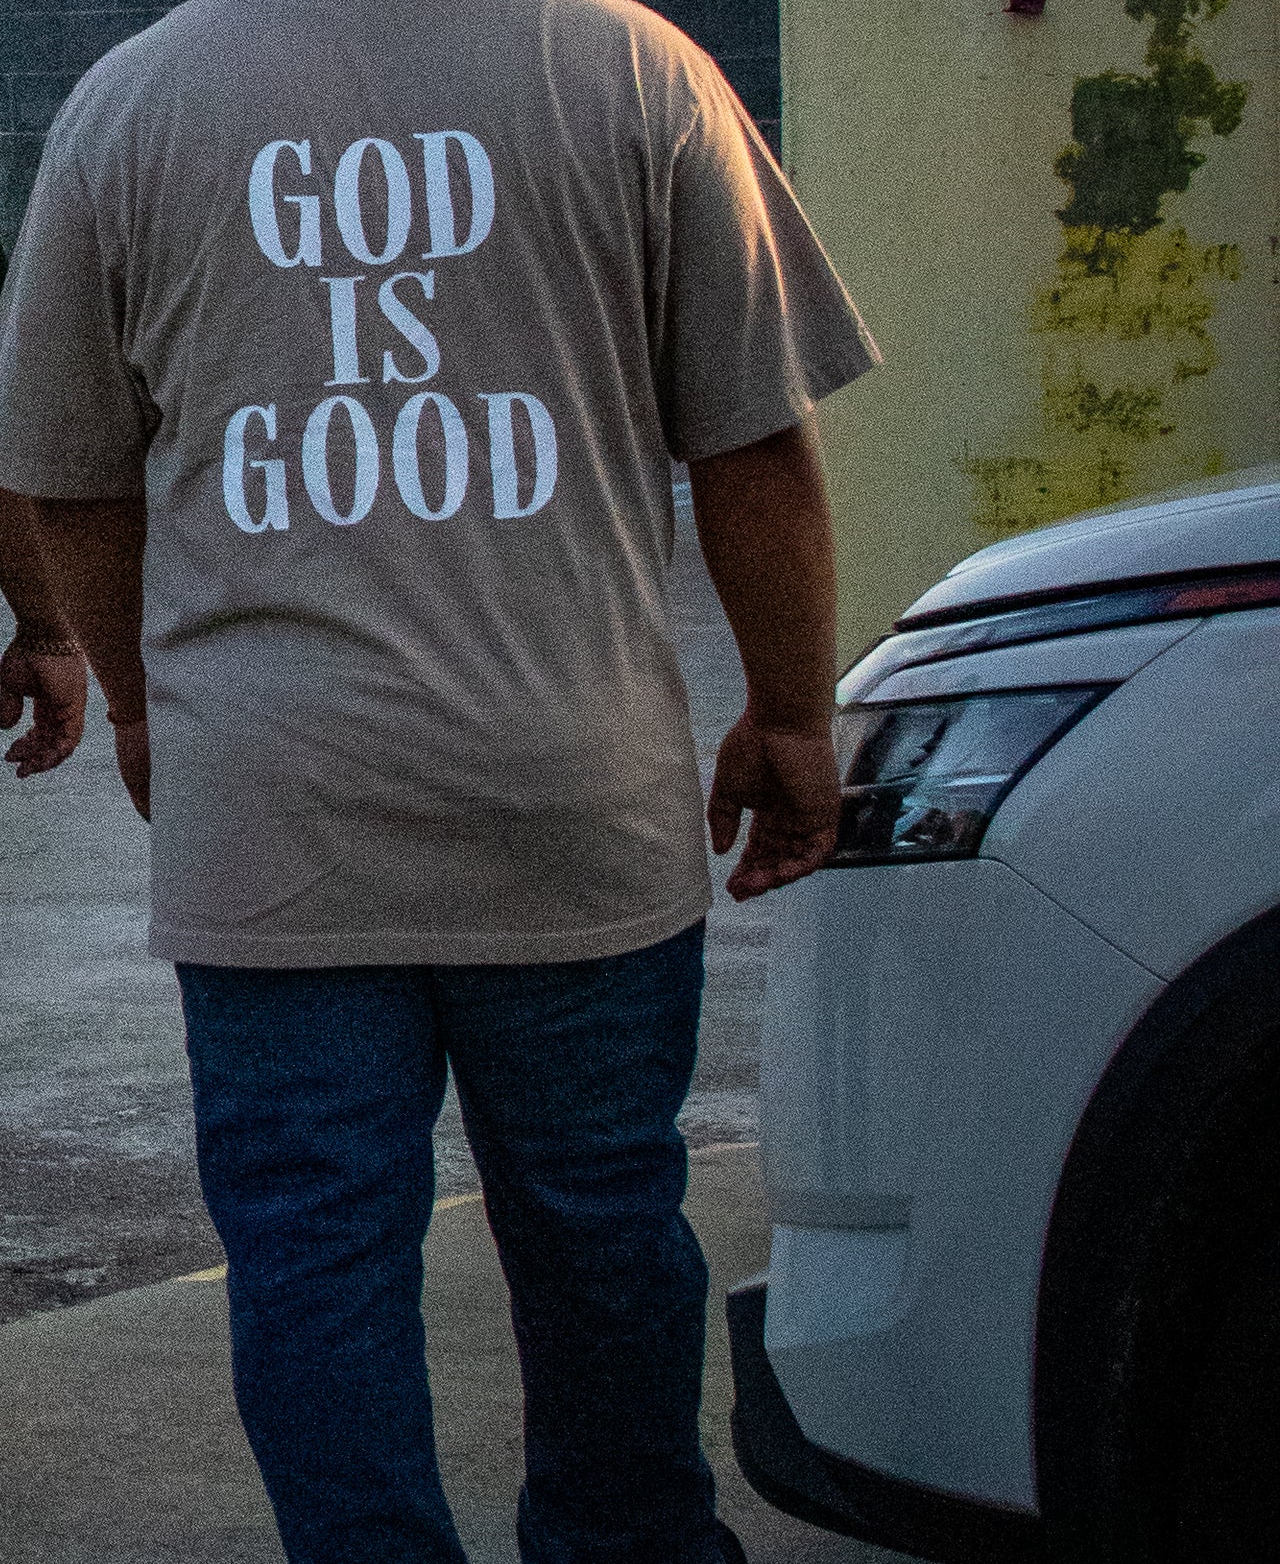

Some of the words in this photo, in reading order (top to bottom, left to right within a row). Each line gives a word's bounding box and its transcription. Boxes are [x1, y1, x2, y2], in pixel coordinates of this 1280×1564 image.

[247, 130, 496, 268] GOD
[320, 270, 441, 387] IS
[222, 391, 558, 534] GOOD
